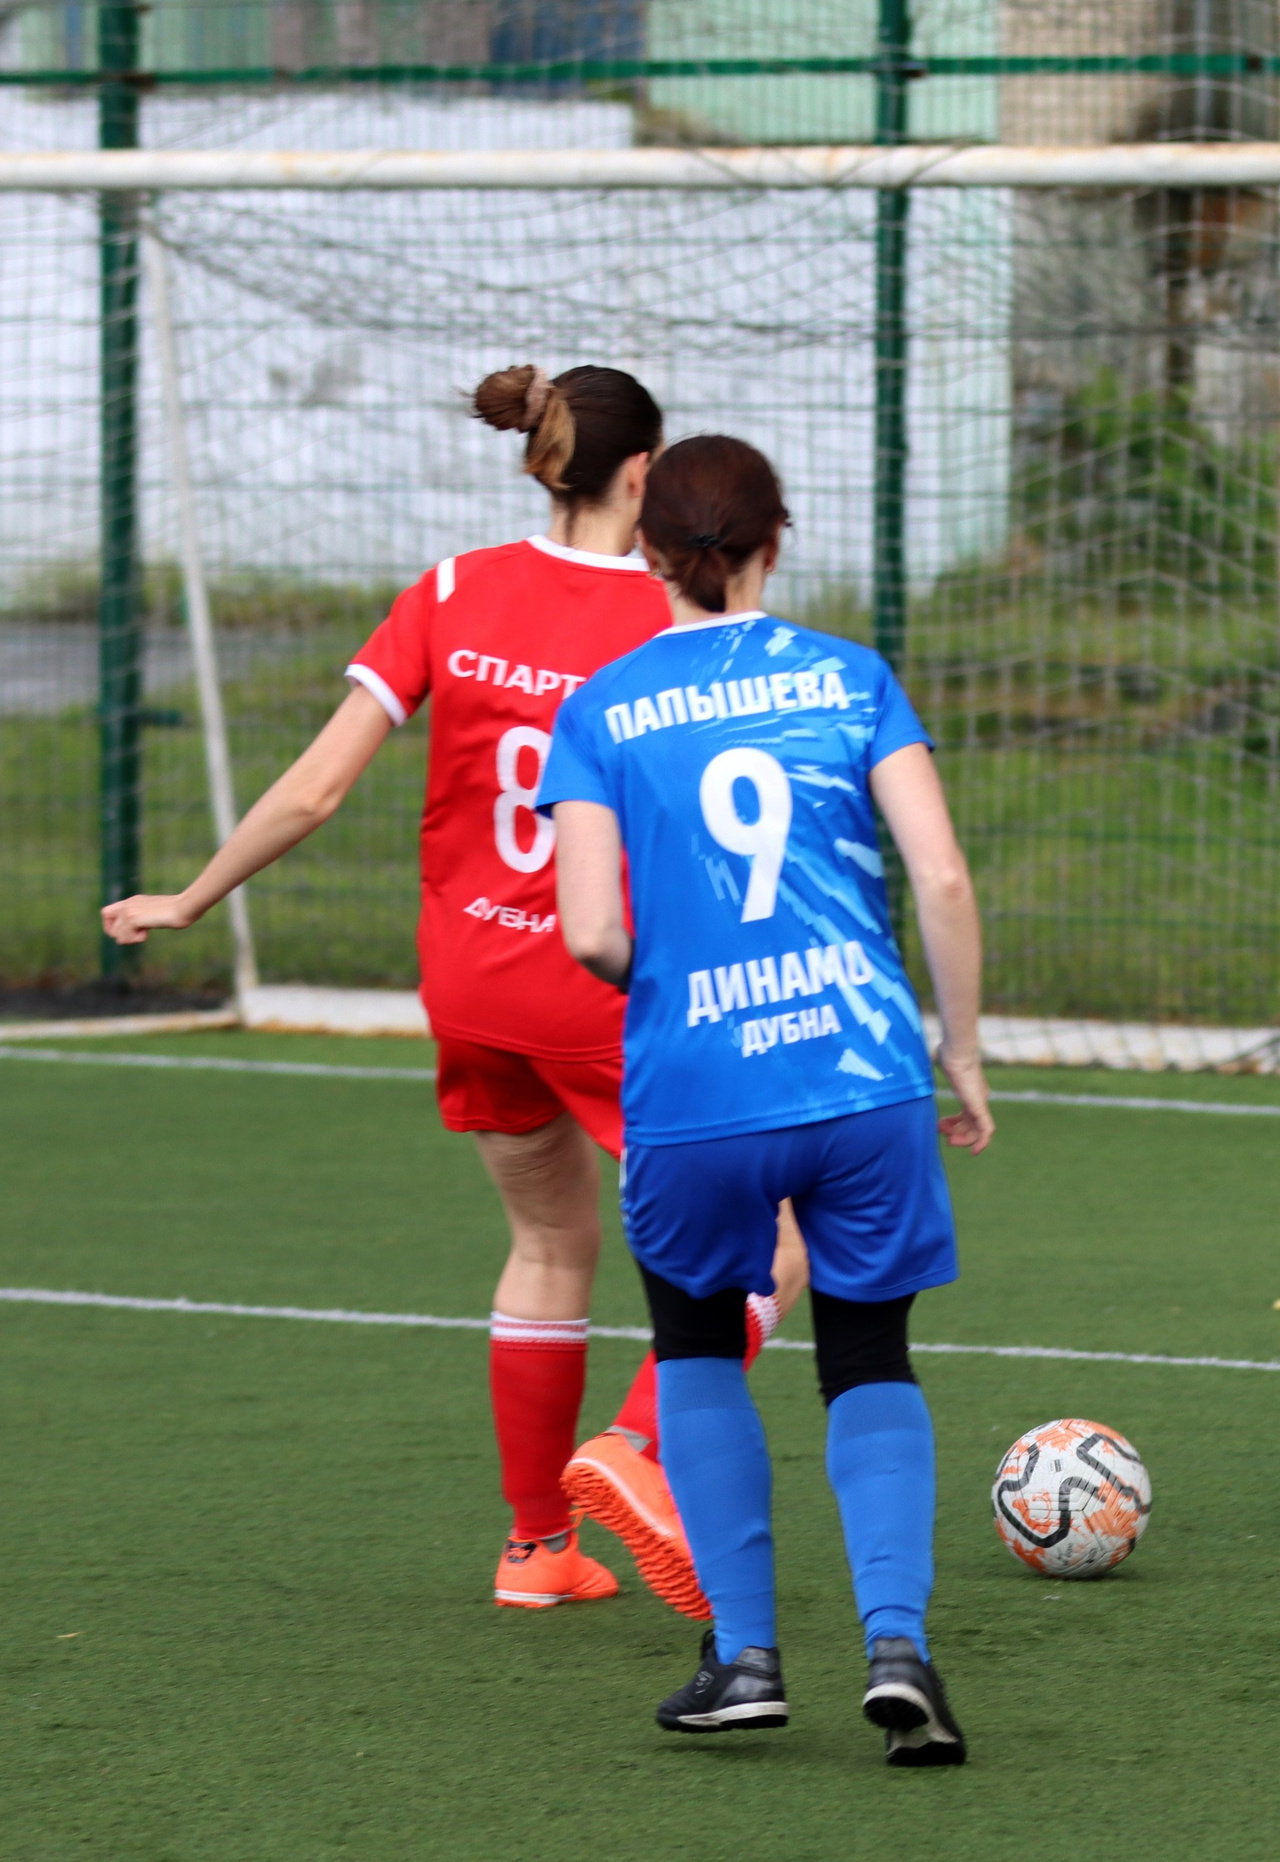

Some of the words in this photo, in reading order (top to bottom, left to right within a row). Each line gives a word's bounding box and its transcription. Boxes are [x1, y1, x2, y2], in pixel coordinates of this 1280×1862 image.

[604, 670, 851, 744] ПАПЫШЕВА
[493, 725, 558, 874] 8
[700, 746, 792, 925] 9
[463, 896, 557, 933] ДУБНА
[686, 939, 875, 1028] ДИНАМО
[740, 1003, 843, 1058] ДУБНА
